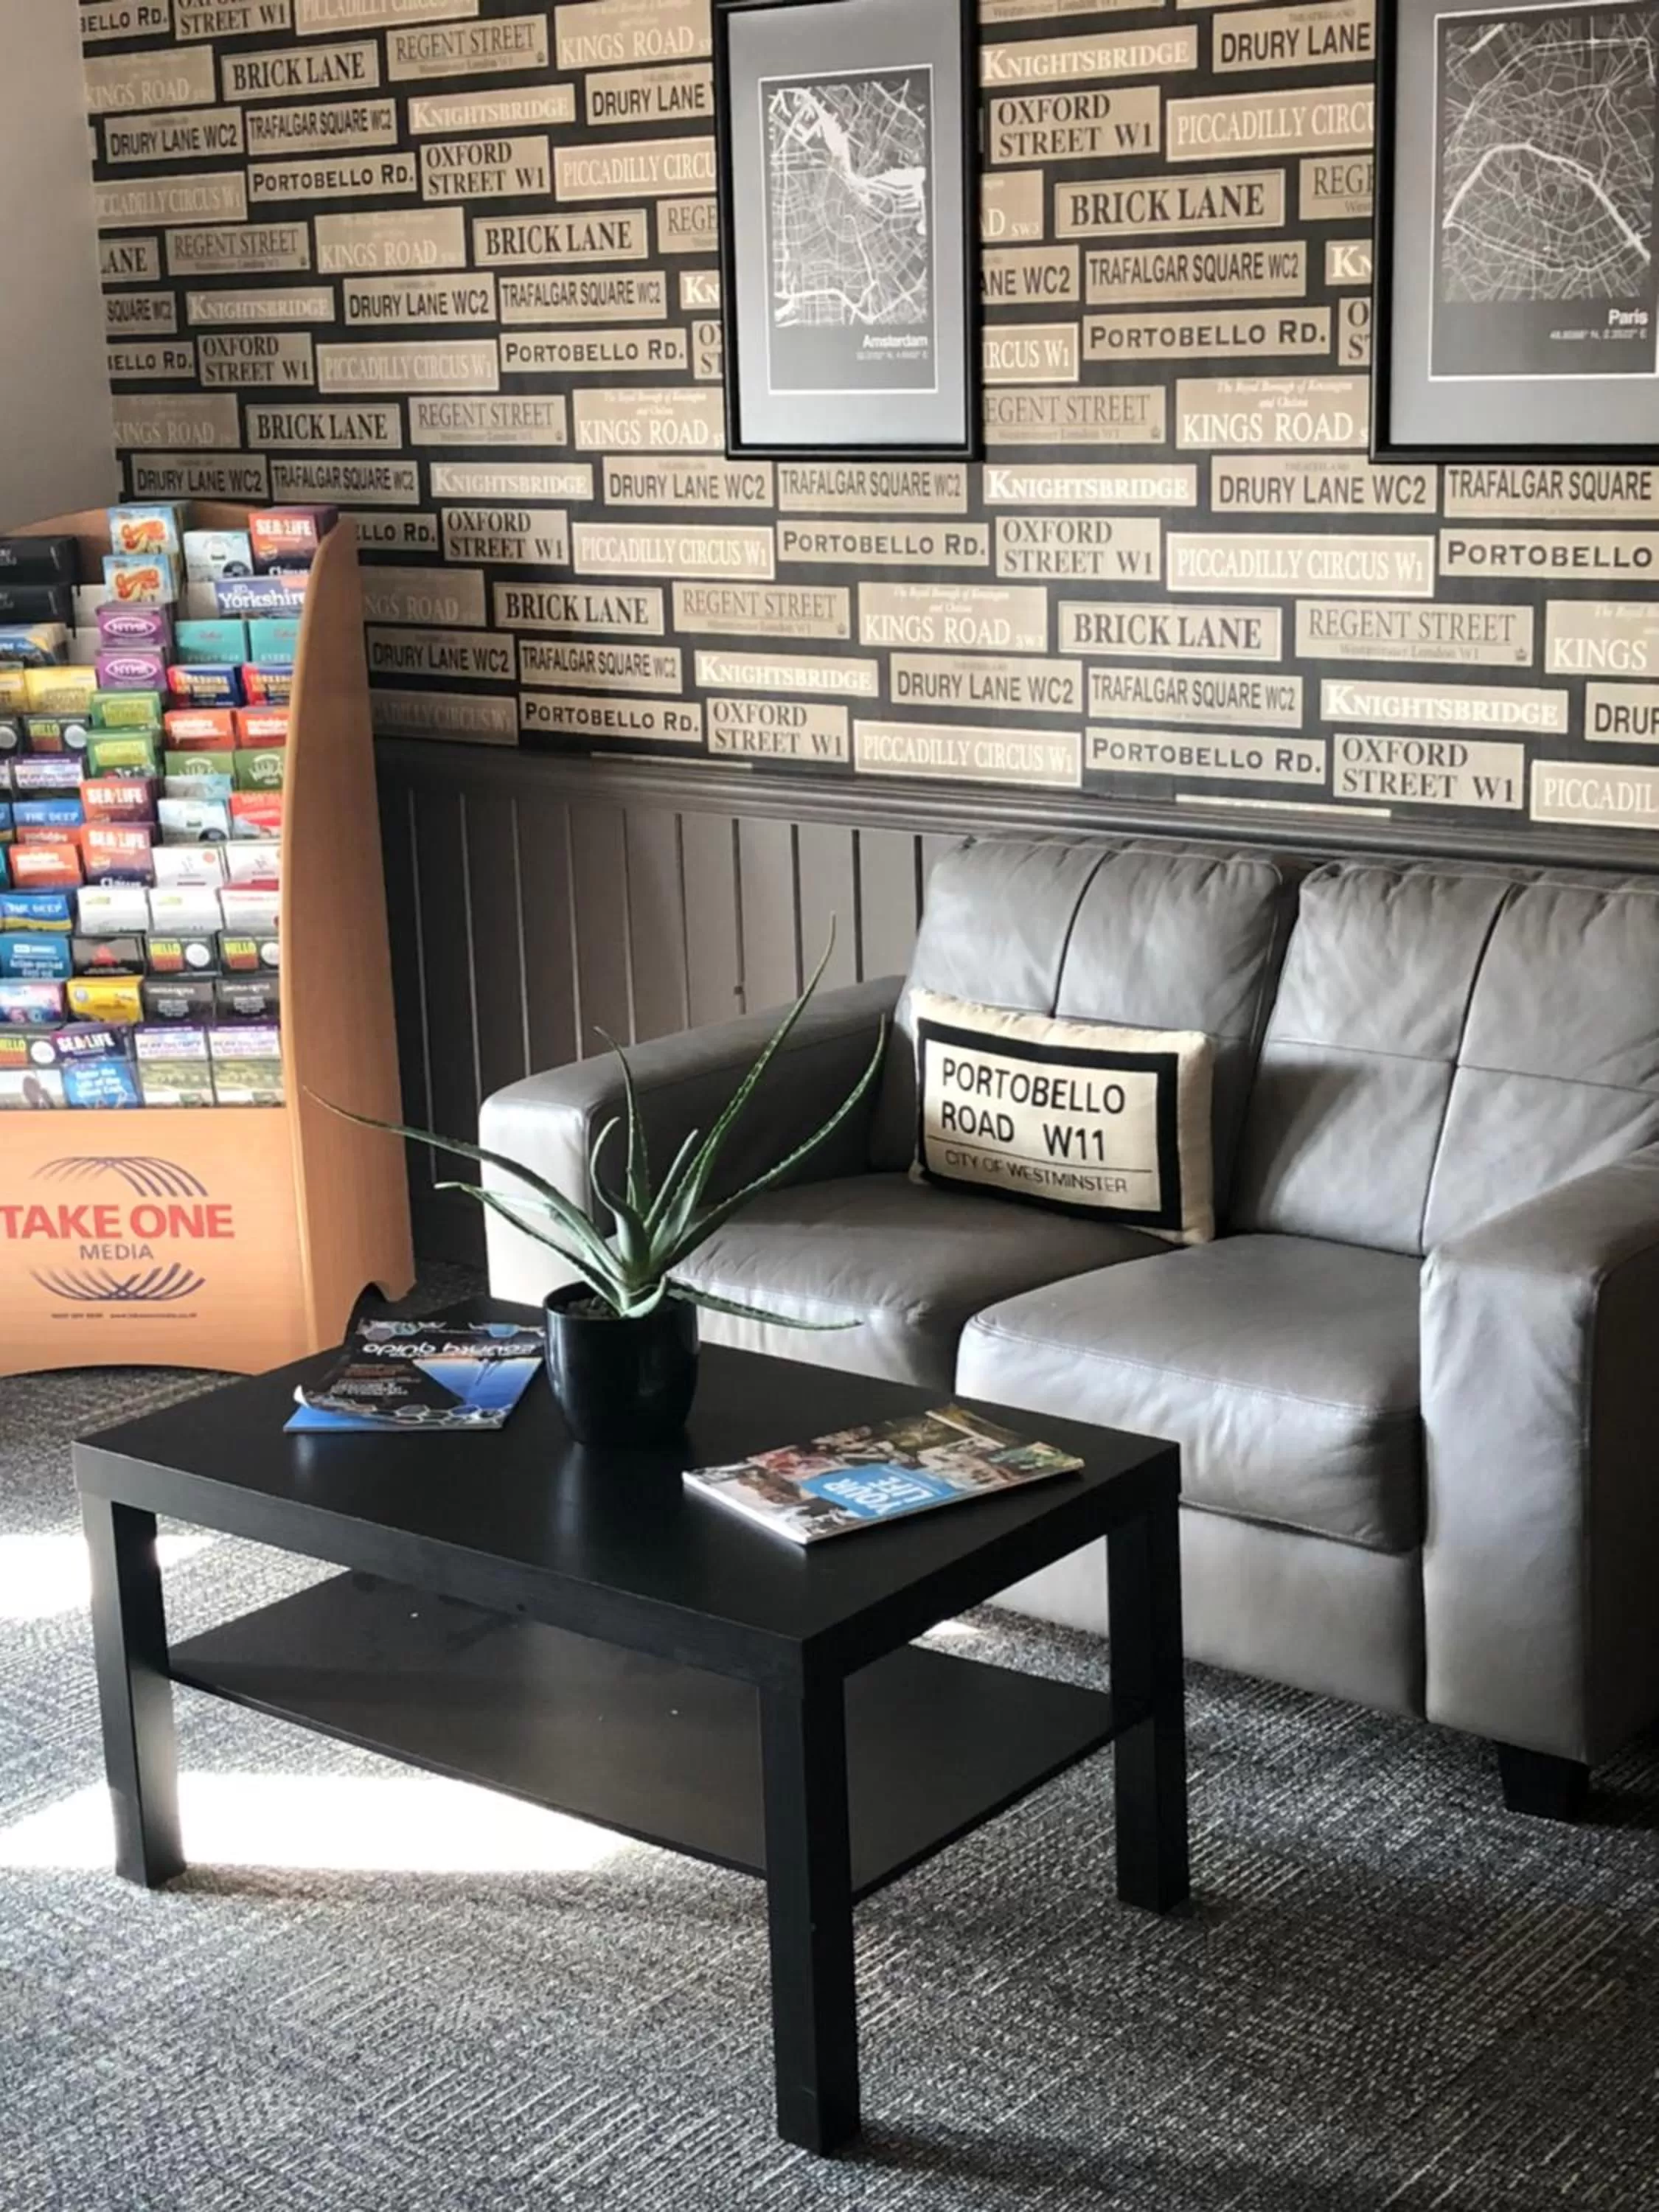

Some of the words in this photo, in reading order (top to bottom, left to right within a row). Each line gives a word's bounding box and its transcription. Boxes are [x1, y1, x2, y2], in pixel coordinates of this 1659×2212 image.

[181, 8, 251, 35] STREET
[260, 4, 285, 24] W1
[395, 30, 465, 61] REGENT
[471, 23, 536, 54] STREET
[560, 34, 625, 65] KINGS
[633, 25, 694, 57] ROAD
[1220, 28, 1301, 64] DRURY
[1308, 22, 1371, 56] LANE
[233, 57, 302, 92] BRICK
[305, 51, 366, 85] LANE
[982, 41, 1189, 80] KNIGHTSBRIDGE
[412, 97, 569, 130] KNIGHTSBRIDGE
[592, 88, 652, 117] DRURY
[658, 83, 705, 112] LANE
[998, 94, 1110, 126] OXFORD
[109, 131, 159, 157] DRURY
[161, 128, 201, 153] LANE
[204, 124, 237, 147] WC2
[426, 142, 512, 168] OXFORD
[998, 126, 1102, 159] STREET
[1116, 122, 1152, 149] W1
[428, 170, 506, 196] STREET
[516, 168, 545, 189] W1
[1070, 188, 1173, 226] BRICK
[1179, 183, 1265, 220] LANE
[174, 234, 237, 258] REGENT
[240, 229, 299, 254] STREET
[486, 227, 561, 256] BRICK
[565, 221, 632, 252] LANE
[321, 242, 378, 270] KINGS
[384, 240, 438, 267] ROAD
[1089, 257, 1189, 286] TRAFALGAR
[1193, 252, 1264, 282] SQUARE
[1268, 253, 1298, 280] WC2
[349, 296, 401, 319] DRURY
[406, 293, 448, 316] LANE
[451, 290, 489, 314] WC2
[502, 282, 577, 308] TRAFALGAR
[580, 280, 634, 305] SQUARE
[637, 282, 661, 304] WC2
[1608, 308, 1649, 325] Paris
[202, 336, 279, 357] OXFORD
[1091, 324, 1266, 349] PORTOBELLO
[205, 361, 274, 383] STREET
[282, 360, 308, 381] W1
[324, 352, 414, 381] PICCADILLY
[414, 352, 470, 380] CIRCUS
[473, 358, 492, 379] W1
[257, 415, 327, 441] BRICK
[330, 413, 389, 440] LANE
[417, 403, 487, 428] REGENT
[491, 402, 554, 427] STREET
[1183, 413, 1263, 442] KINGS
[1275, 412, 1354, 439] ROAD
[580, 420, 641, 447] KINGS
[648, 419, 709, 446] ROAD
[136, 468, 184, 493] DRURY
[188, 469, 226, 492] LANE
[229, 470, 263, 493] WC2
[435, 467, 588, 495] KNIGHTSBRIDGE
[610, 474, 667, 498] DRURY
[673, 475, 720, 499] LANE
[723, 475, 765, 501] WC2
[781, 470, 866, 495] TRAFALGAR
[870, 471, 931, 497] SQUARE
[934, 472, 961, 497] WC2
[987, 470, 1189, 500] KNIGHTSBRIDGE
[1219, 476, 1296, 504] DRURY
[1304, 476, 1365, 504] LANE
[1372, 475, 1426, 505] WC2
[1449, 469, 1563, 499] TRAFALGAR
[1568, 470, 1652, 501] SQUARE
[448, 510, 531, 532] OXFORD
[1003, 521, 1113, 545] OXFORD
[449, 538, 526, 559] STREET
[535, 539, 563, 560] W1
[581, 538, 676, 566] PICCADILLY
[679, 539, 741, 567] CIRCUS
[745, 540, 768, 567] W1
[784, 530, 933, 554] PORTOBELLO
[1448, 540, 1653, 568] PORTOBELLO
[1004, 549, 1105, 574] STREET
[1118, 552, 1153, 574] W1
[1178, 548, 1302, 580] PICCADILLY
[1307, 549, 1389, 581] CIRCUS
[1394, 552, 1426, 582] W1
[505, 593, 579, 622] BRICK
[585, 596, 649, 625] LANE
[684, 590, 761, 616] REGENT
[765, 594, 838, 619] STREET
[1074, 612, 1169, 646] BRICK
[1177, 616, 1262, 650] LANE
[1309, 609, 1411, 639] REGENT
[1418, 612, 1517, 642] STREET
[372, 642, 425, 668] DRURY
[428, 645, 470, 670] LANE
[471, 648, 509, 672] WC2
[1554, 638, 1648, 670] KINGS
[700, 655, 872, 690] KNIGHTSBRIDGE
[897, 670, 963, 699] DRURY
[970, 672, 1020, 703] LANE
[1027, 674, 1074, 705] WC2
[1092, 673, 1187, 706] TRAFALGAR
[1192, 680, 1262, 709] SQUARE
[1265, 685, 1295, 712] WC2
[1326, 684, 1558, 726] KNIGHTSBRIDGE
[712, 702, 807, 728] OXFORD
[714, 728, 801, 754] STREET
[811, 734, 843, 757] W1
[862, 734, 970, 766] PICCADILLY
[974, 741, 1044, 770] CIRCUS
[1048, 746, 1074, 773] W1
[1092, 738, 1263, 769] PORTOBELLO
[1343, 740, 1469, 768] OXFORD
[1342, 768, 1458, 799] STREET
[1473, 776, 1515, 803] W1
[942, 1057, 1125, 1114] PORTOBELLO
[941, 1102, 1015, 1142] ROAD
[1043, 1124, 1104, 1161] W11
[945, 1149, 978, 1170] CITY
[982, 1156, 1004, 1173] OF
[1009, 1164, 1128, 1193] WESTMINSTER
[0, 1204, 122, 1239] TAKE
[129, 1203, 235, 1239] ONE
[80, 1244, 154, 1260] MEDIA
